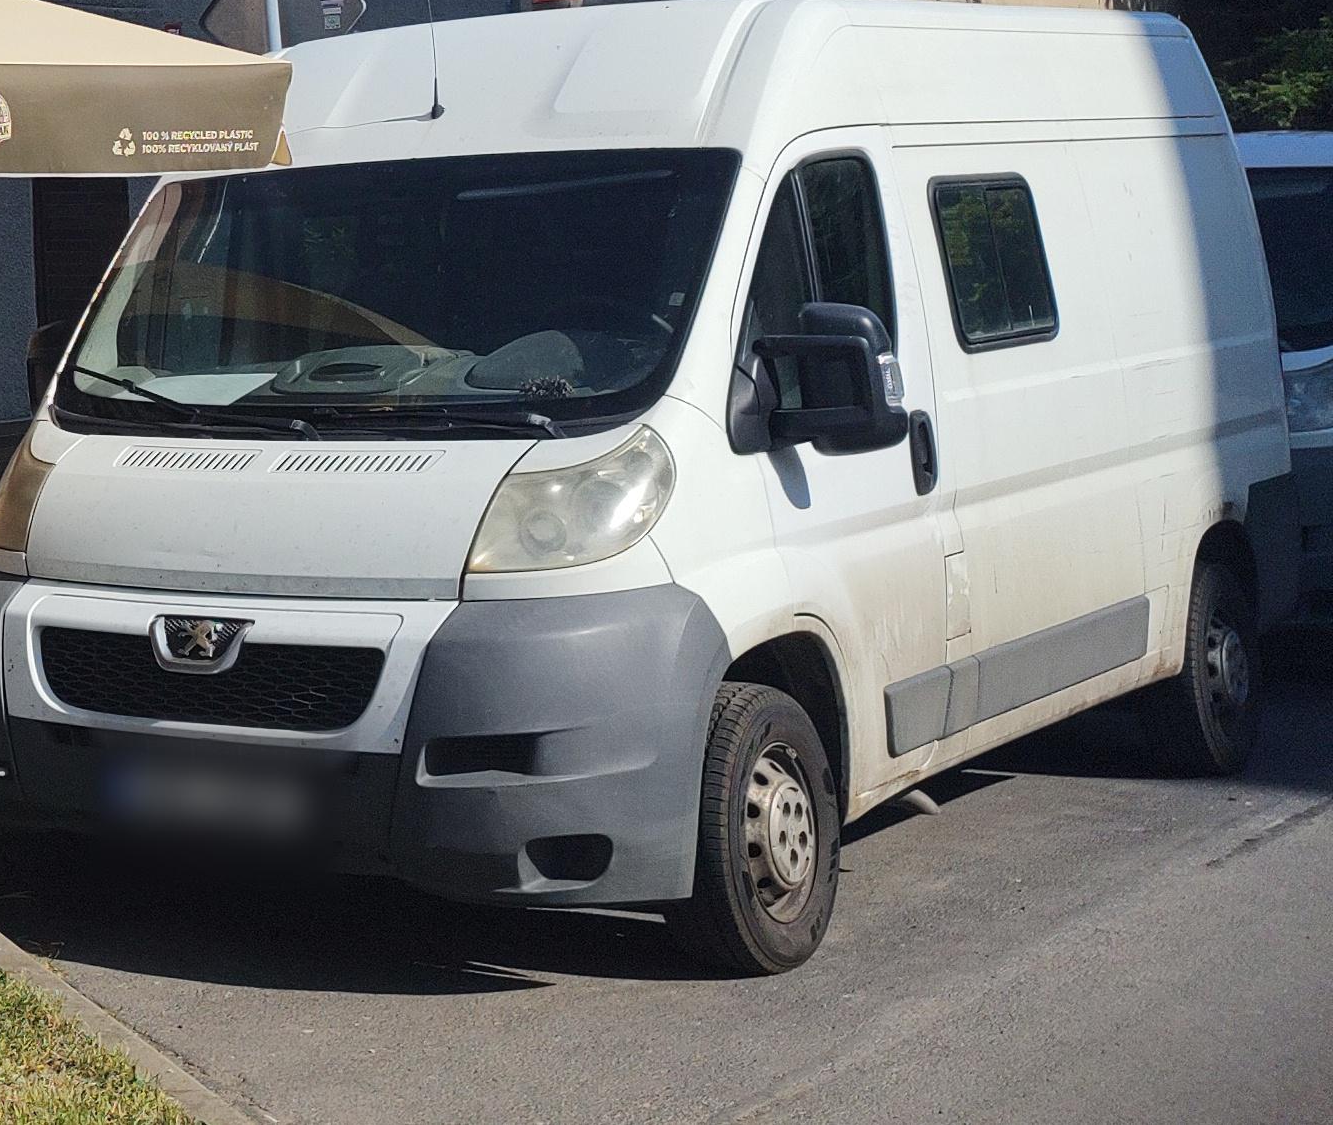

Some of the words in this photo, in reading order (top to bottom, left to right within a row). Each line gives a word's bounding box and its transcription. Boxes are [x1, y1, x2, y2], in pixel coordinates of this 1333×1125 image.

[142, 131, 159, 141] 100
[171, 130, 217, 140] RECYCLED
[142, 144, 166, 154] 100%
[235, 142, 259, 152] PLAST
